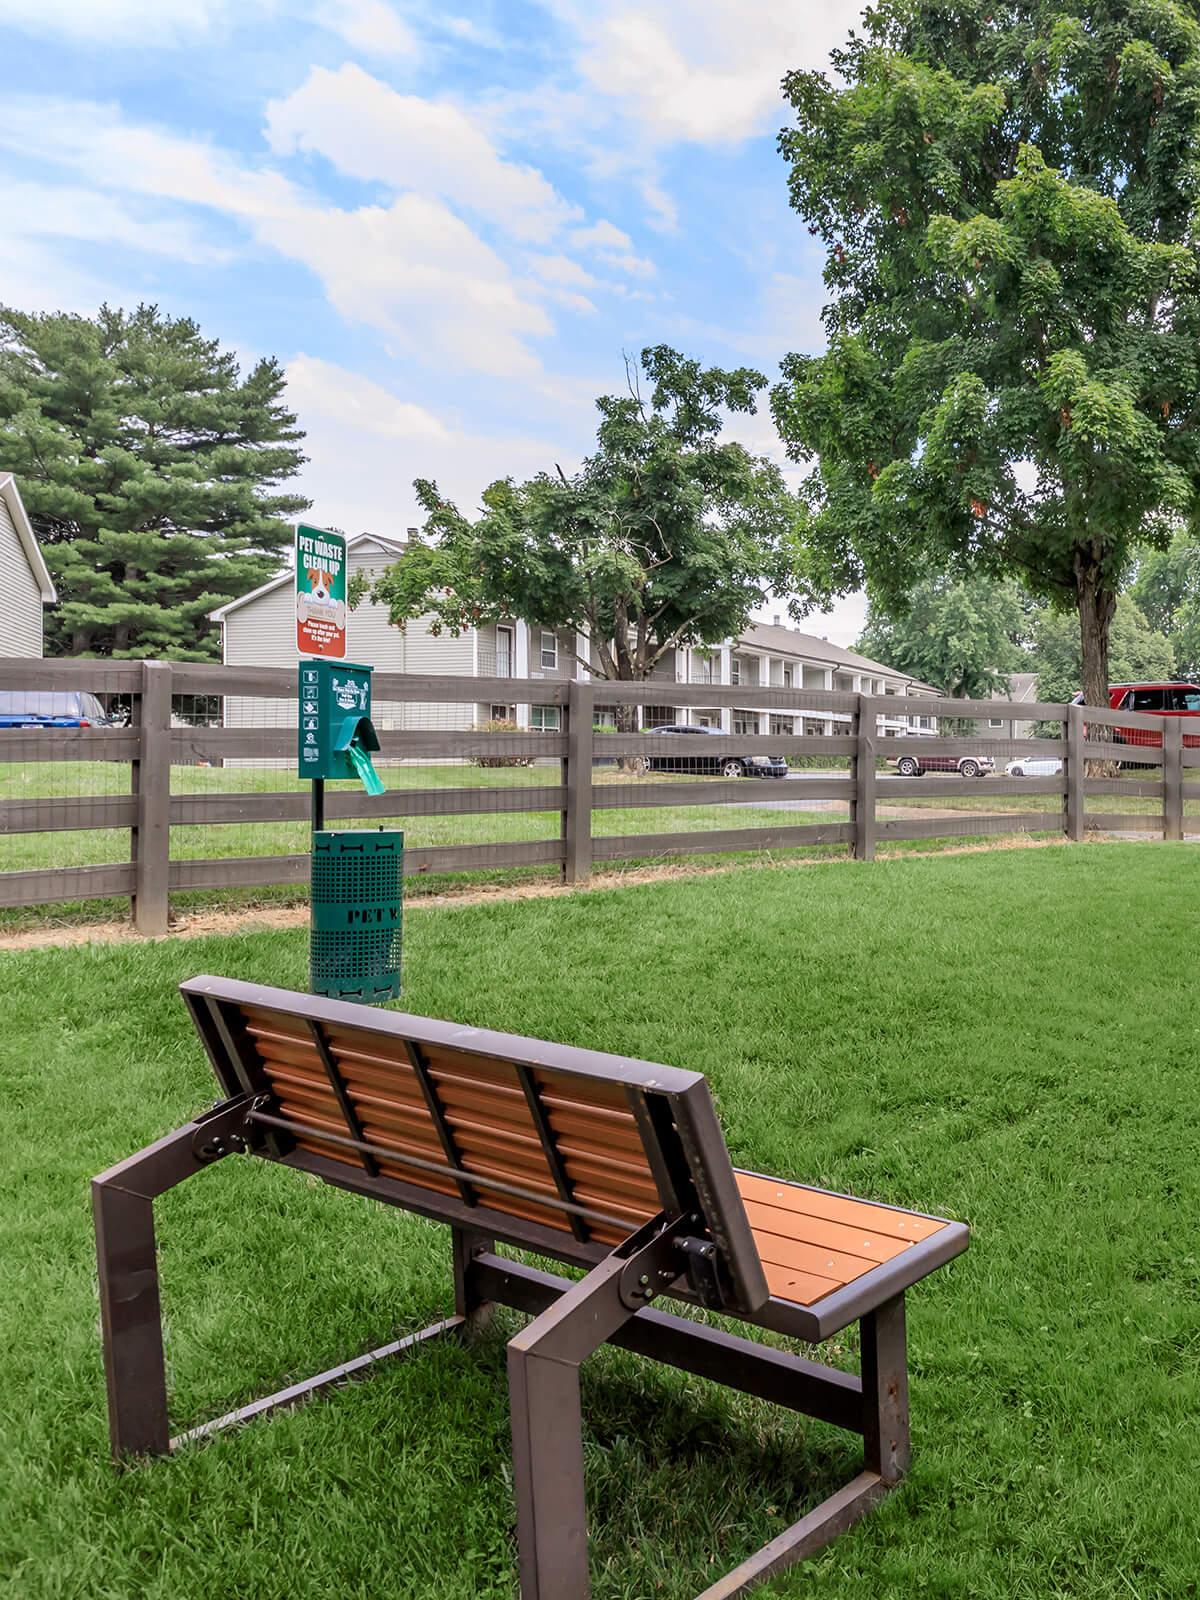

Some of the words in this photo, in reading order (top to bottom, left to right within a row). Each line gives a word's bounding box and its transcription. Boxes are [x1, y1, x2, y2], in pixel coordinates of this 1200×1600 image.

[299, 535, 314, 553] PET
[314, 539, 343, 561] WASTE
[303, 553, 328, 573] CLEAN
[329, 559, 340, 576] UP
[324, 607, 336, 618] YOU
[347, 906, 385, 924] PET
